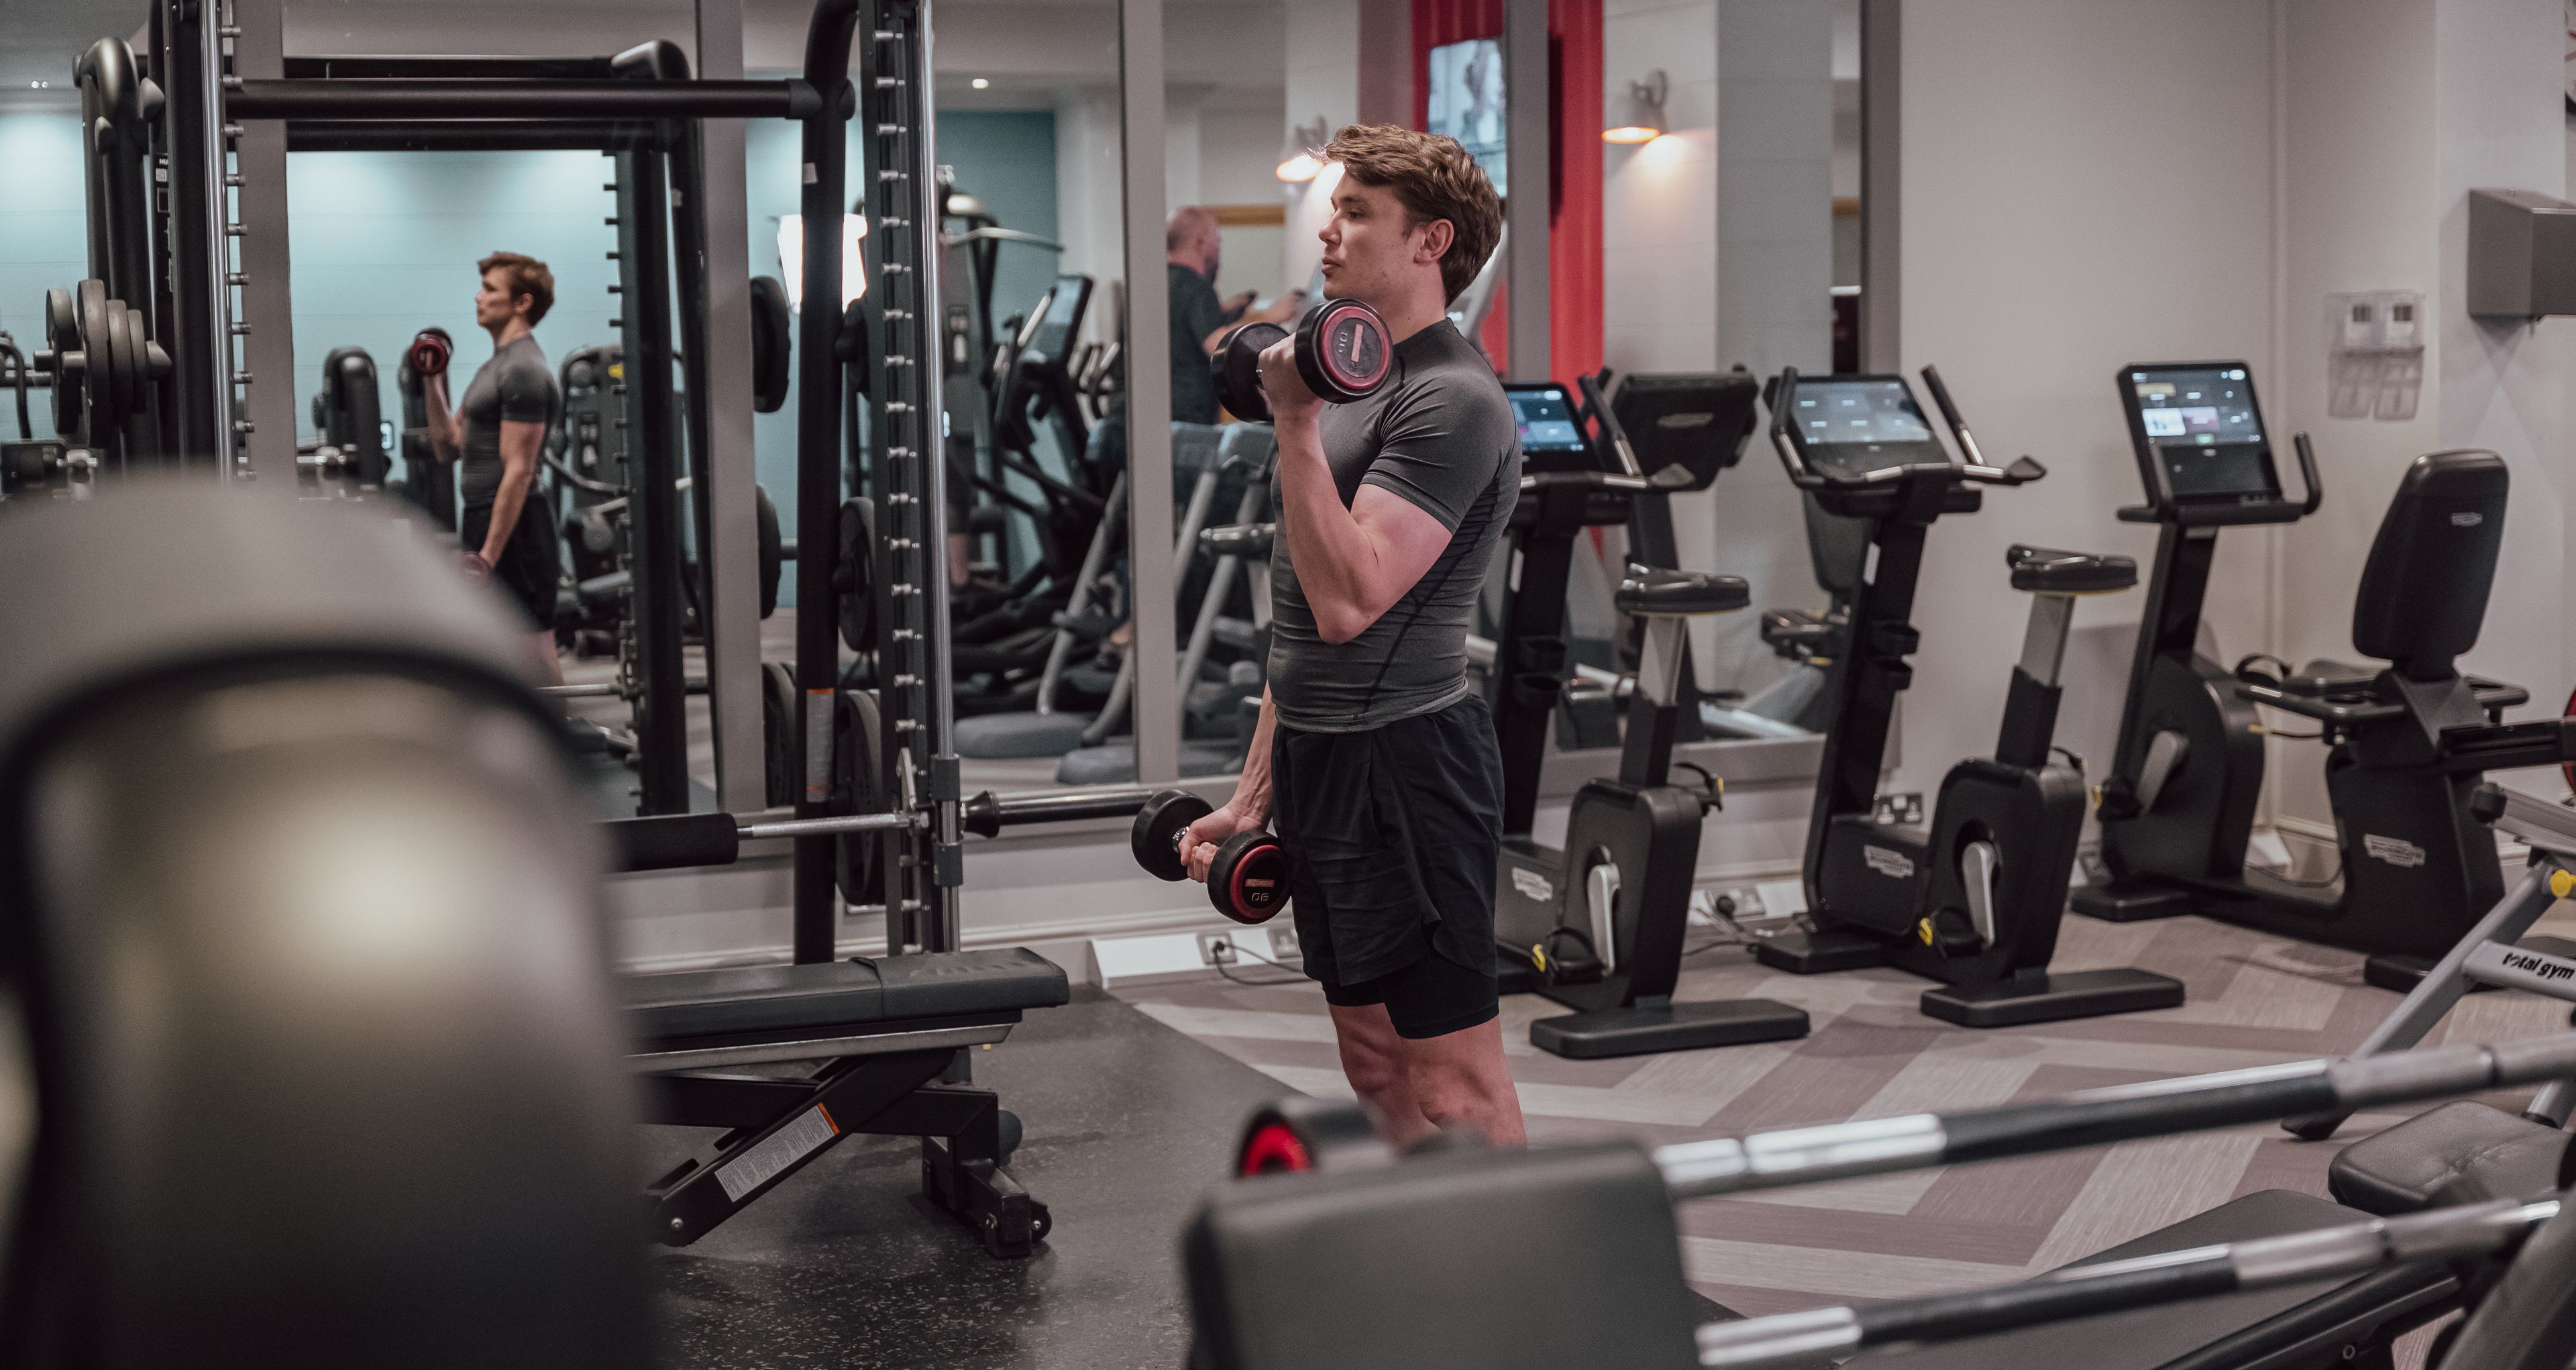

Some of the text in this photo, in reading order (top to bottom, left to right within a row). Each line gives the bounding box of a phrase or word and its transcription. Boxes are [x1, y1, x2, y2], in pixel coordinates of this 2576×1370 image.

[1251, 892, 1270, 902] 06
[2502, 953, 2575, 979] total gym
